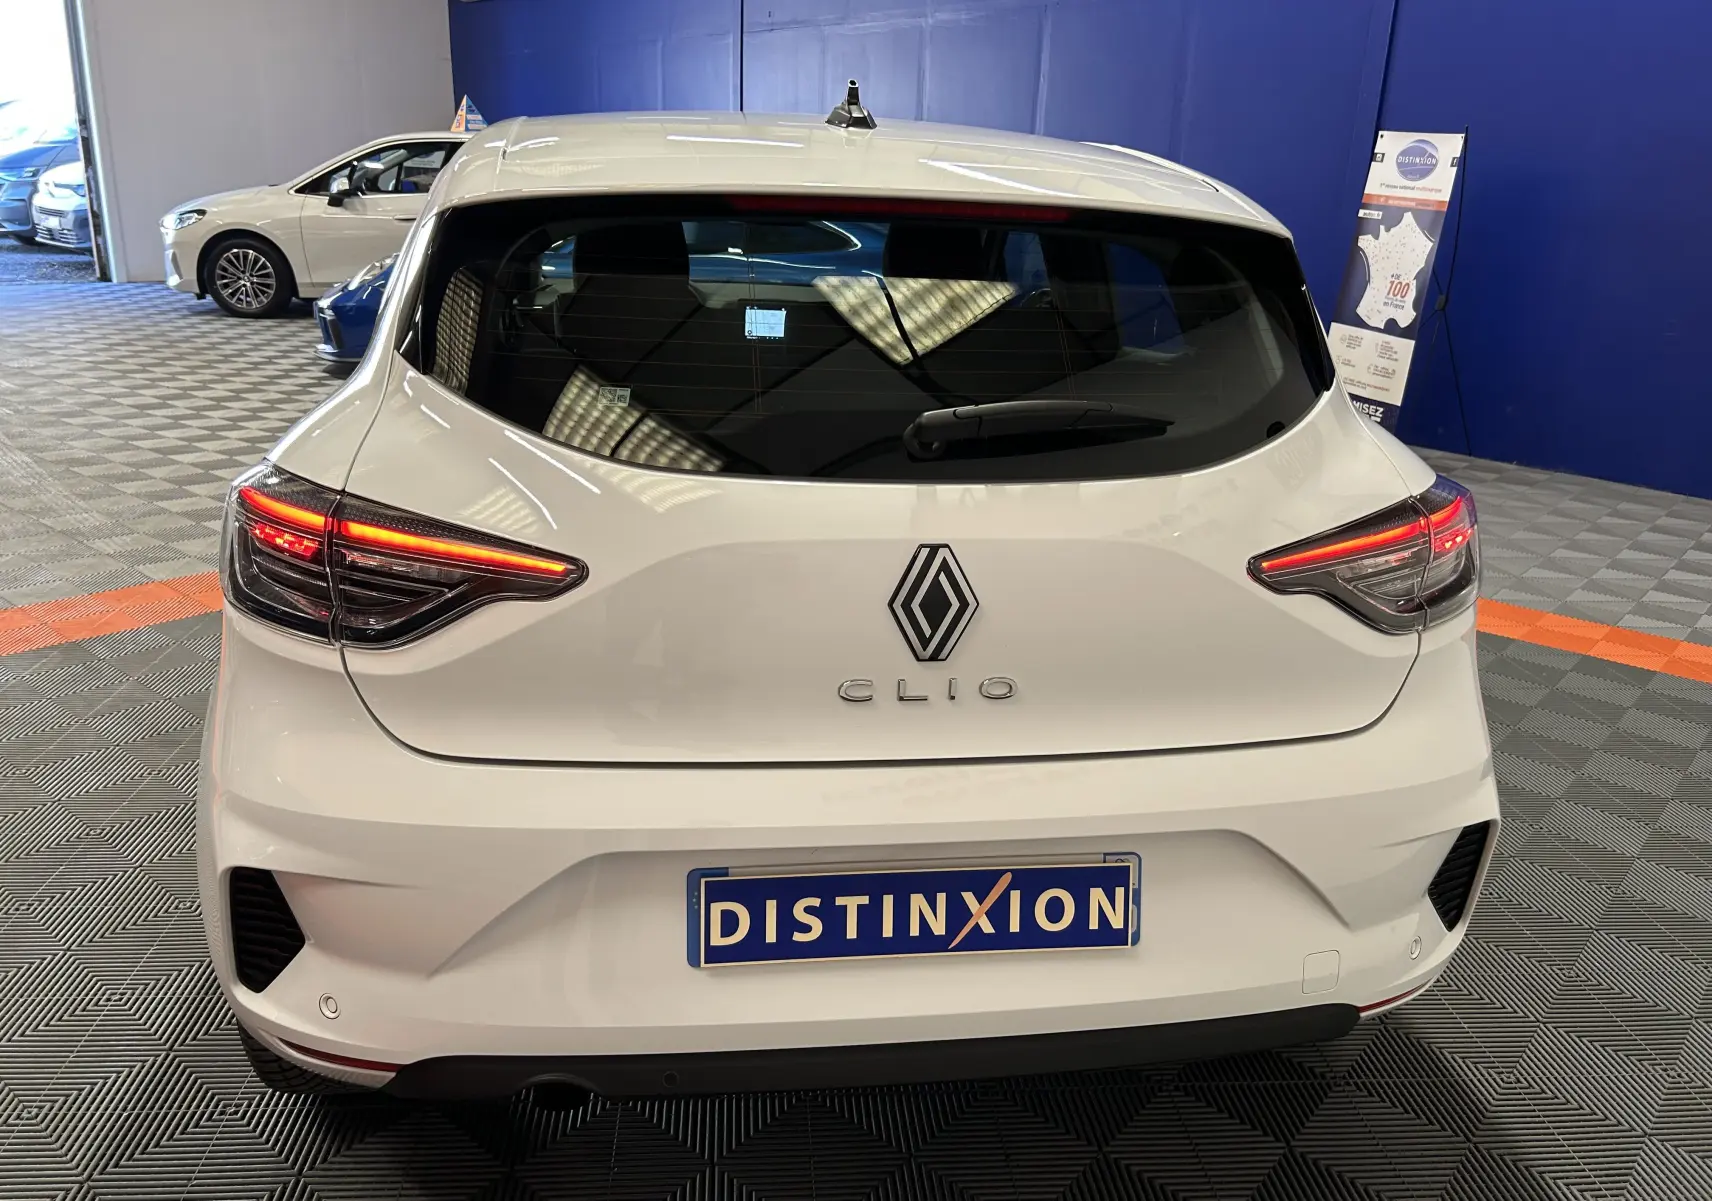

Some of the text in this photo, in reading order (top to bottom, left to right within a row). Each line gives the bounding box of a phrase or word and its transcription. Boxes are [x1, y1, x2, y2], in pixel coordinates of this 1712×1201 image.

[1397, 156, 1437, 165] DISTINXION
[1387, 280, 1410, 299] 100
[1390, 301, 1405, 310] France
[838, 676, 1018, 702] CLIO
[708, 872, 1125, 949] DISTINXION
